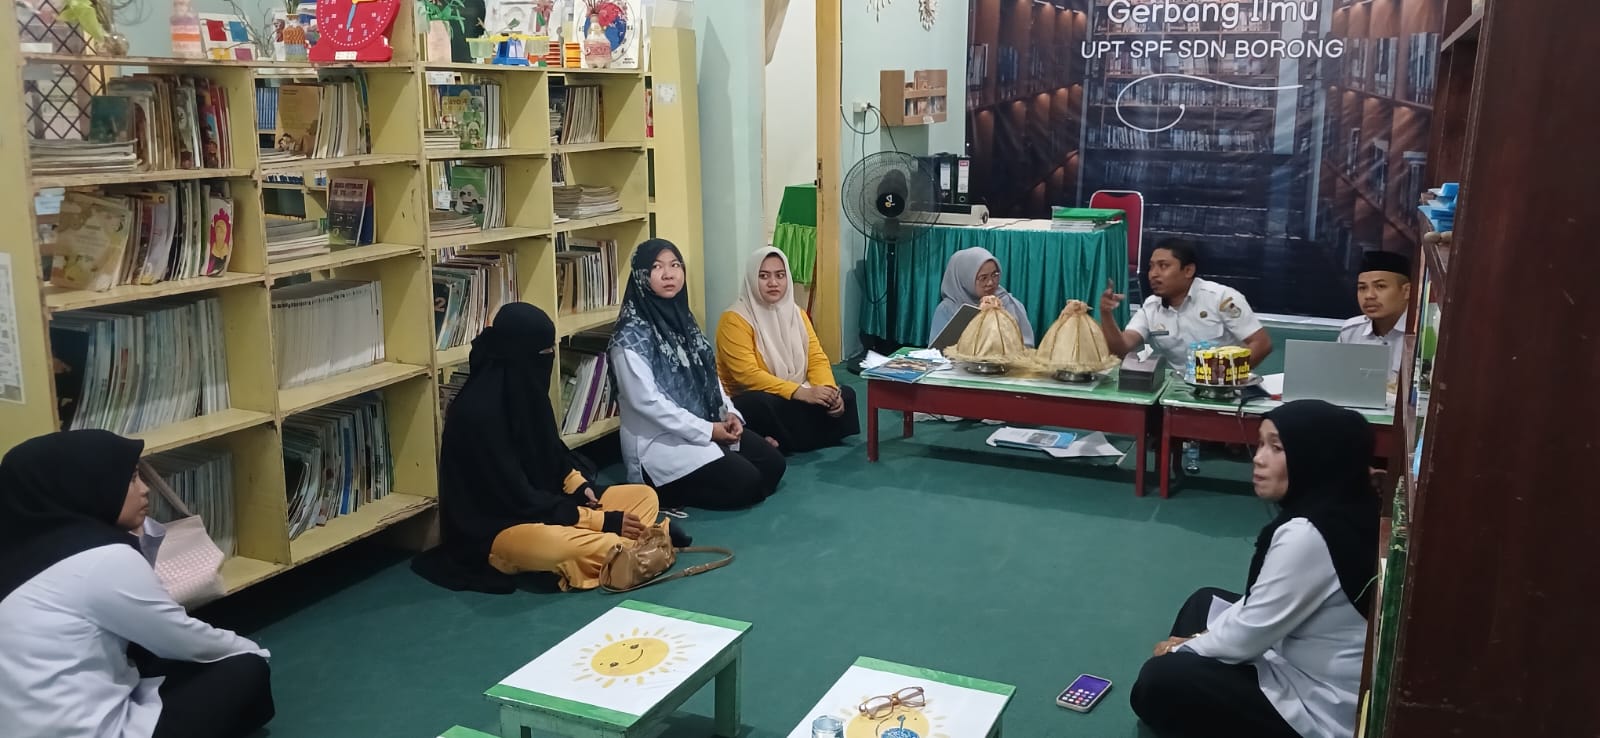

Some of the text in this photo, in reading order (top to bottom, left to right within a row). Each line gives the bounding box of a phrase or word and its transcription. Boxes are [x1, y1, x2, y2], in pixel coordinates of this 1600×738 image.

[1107, 0, 1318, 29] Gerbang Ilmu
[1081, 39, 1344, 58] UPT SPF SDN BORONG
